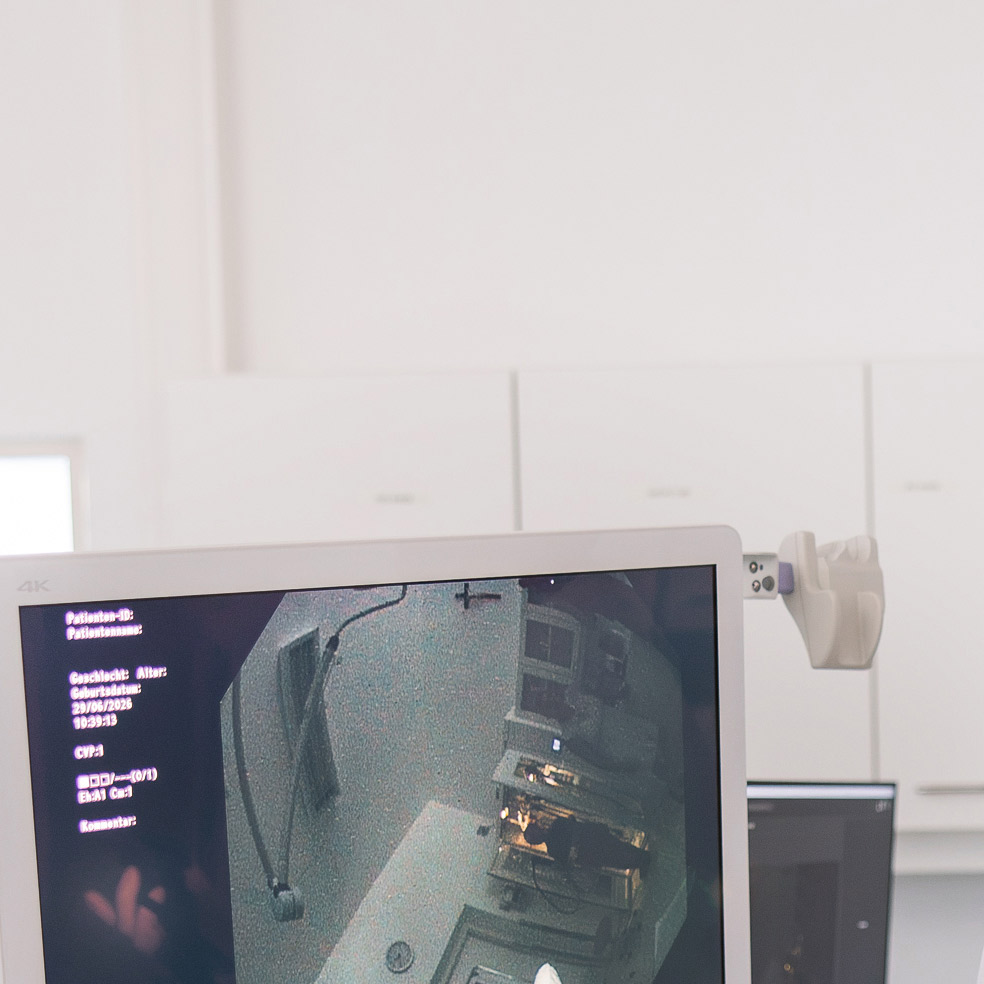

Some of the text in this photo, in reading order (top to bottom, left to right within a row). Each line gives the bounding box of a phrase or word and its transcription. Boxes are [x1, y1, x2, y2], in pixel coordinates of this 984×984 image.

[16, 579, 51, 592] 4K
[66, 608, 133, 625] Patienten-ID:
[66, 624, 142, 640] Patientenname:
[69, 666, 167, 685] Geschlecht: Alter:
[70, 683, 141, 700] Geburtsdatum:
[72, 697, 132, 715] 29/06/2026
[73, 713, 117, 730] 10:39:13
[74, 744, 104, 759] CVP:1
[79, 815, 136, 833] Kommentar:
